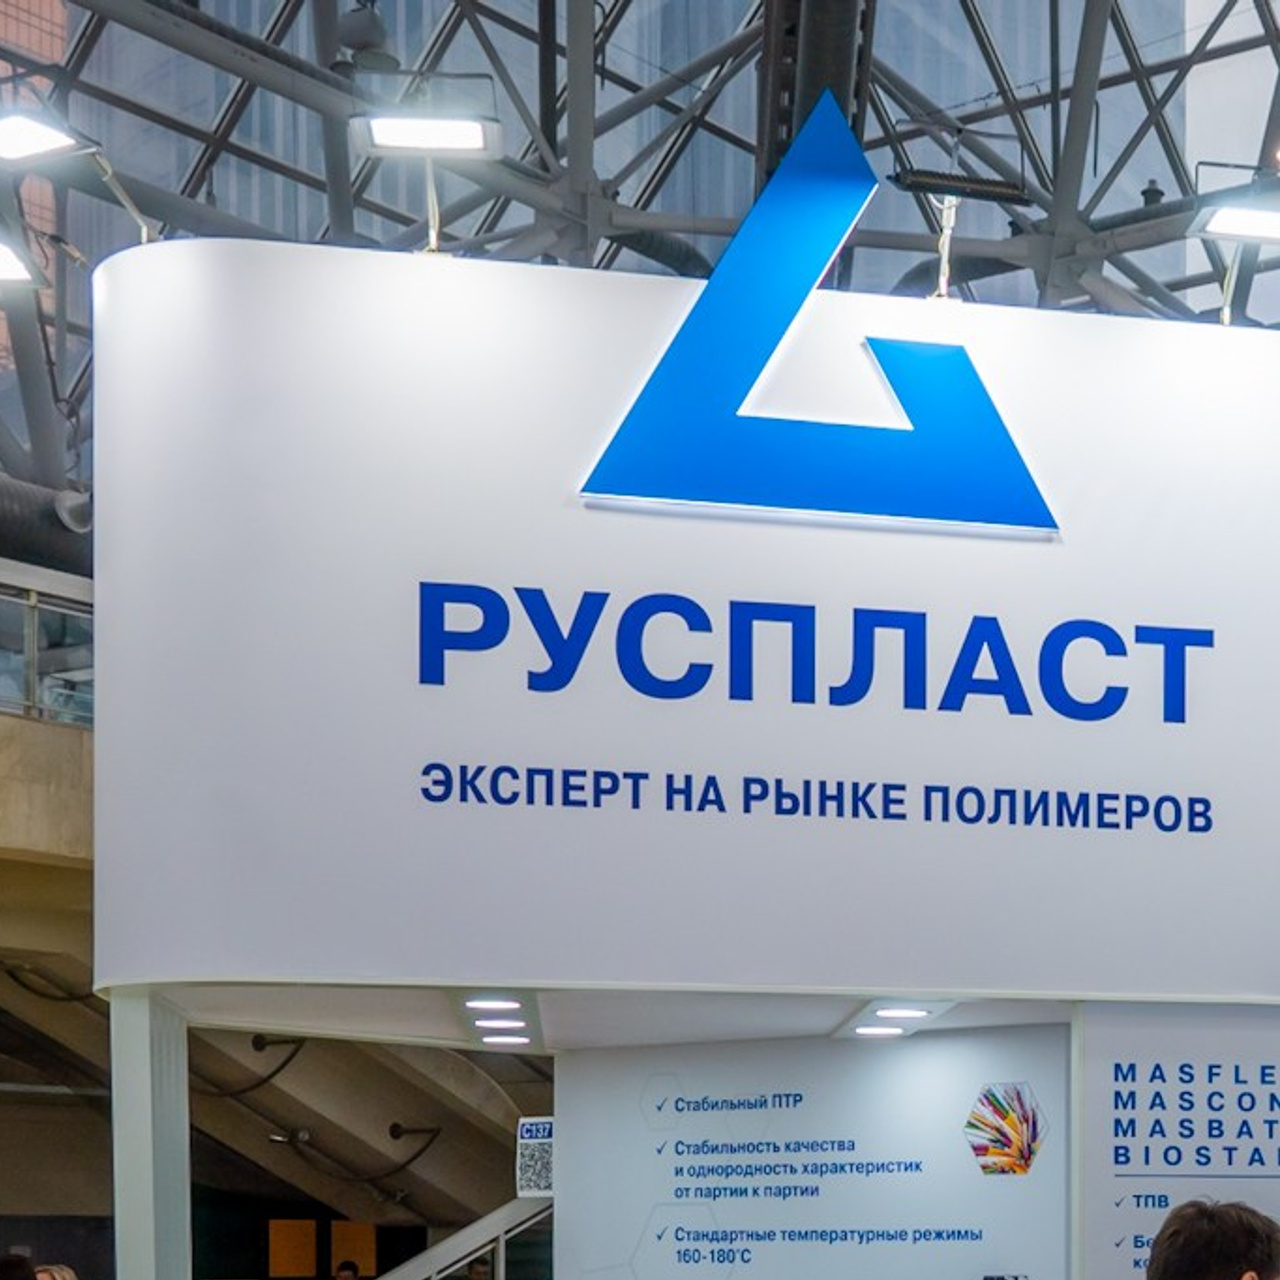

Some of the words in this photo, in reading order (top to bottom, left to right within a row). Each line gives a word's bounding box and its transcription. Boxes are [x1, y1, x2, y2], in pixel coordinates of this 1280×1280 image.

[419, 582, 1214, 723] РУСПЛАСТ
[421, 763, 649, 809] ЭКСПЕРТ
[666, 774, 726, 812] НА
[743, 777, 907, 820] РЫНКЕ
[924, 785, 1212, 833] ПОЛИМЕРОВ
[675, 1095, 768, 1112] Стабильный
[772, 1093, 803, 1108] ПТР
[675, 1140, 781, 1156] Стабильность
[784, 1140, 855, 1153] качества
[675, 1166, 684, 1177] и
[687, 1164, 798, 1179] однородность
[801, 1161, 922, 1178] характеристик
[674, 1187, 691, 1199] от
[694, 1187, 748, 1201] партии
[752, 1187, 759, 1197] к
[764, 1186, 819, 1200] партии
[1132, 1195, 1169, 1208] ТПВ
[675, 1227, 776, 1244] Стандартные
[780, 1230, 908, 1244] температурные
[913, 1229, 982, 1244] режимы
